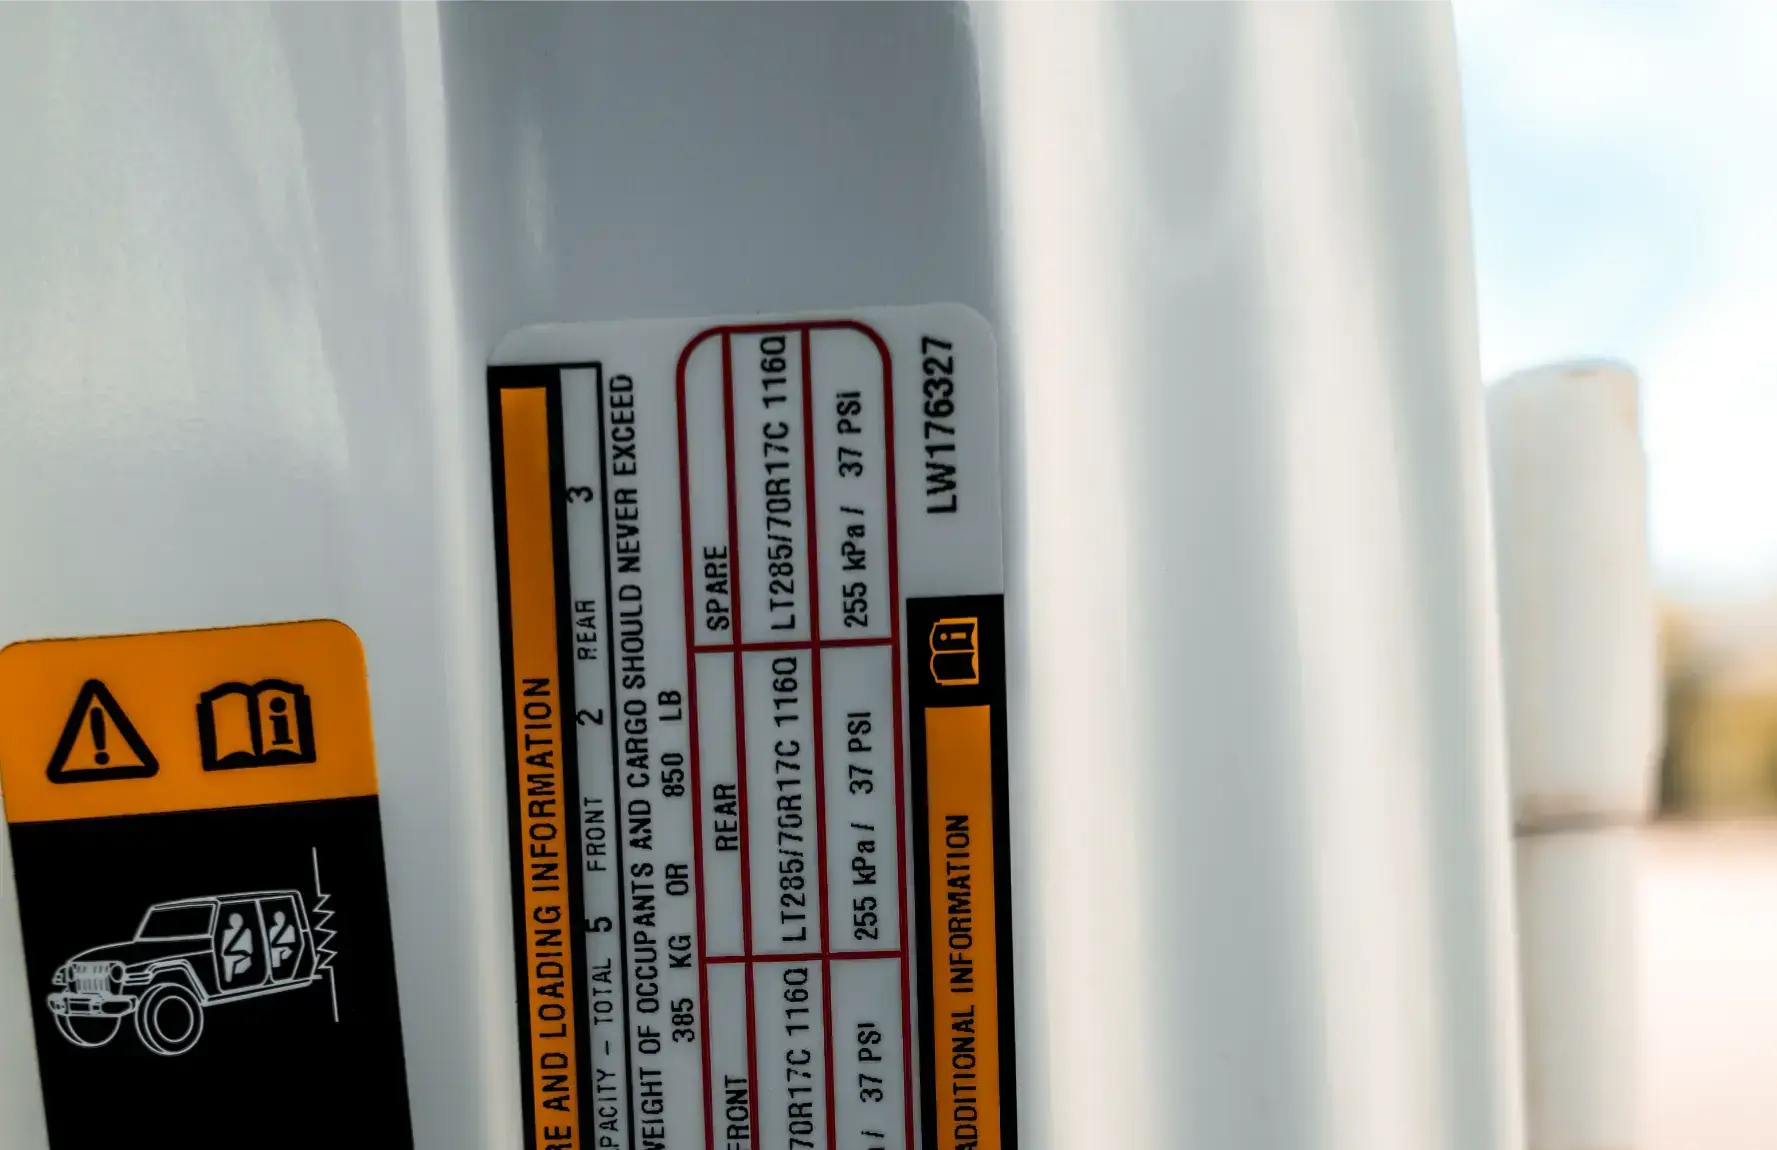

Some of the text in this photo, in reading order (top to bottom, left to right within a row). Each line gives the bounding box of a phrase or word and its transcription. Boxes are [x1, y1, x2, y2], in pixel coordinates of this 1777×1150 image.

[609, 374, 637, 477] EXCEED
[921, 335, 958, 514] LW176327
[565, 486, 594, 506] 3
[759, 335, 796, 630] LT285/70R17C 116Q
[836, 391, 868, 628] 255 kPa / 37 PSI
[614, 488, 641, 573] NEVER
[574, 600, 598, 661] REAR
[703, 545, 730, 631] SPARE
[618, 584, 646, 690] SHOULD
[574, 706, 604, 728] 2
[623, 699, 650, 788] CARGO
[522, 677, 560, 893] INFORMATION
[627, 799, 653, 851] AND
[712, 783, 739, 852] REAR
[771, 656, 807, 942] LT285/70R17C 116Q
[846, 711, 879, 941] 255 kPa / 37 PSI
[583, 796, 607, 872] FRONT
[658, 690, 696, 1043] 385 KG OR 850 LB
[583, 914, 613, 935] 5
[630, 862, 660, 1014] OCCUPANTS
[945, 815, 974, 993] INFORMATION
[532, 904, 568, 1040] LOADING
[591, 957, 614, 1026] TOTAL
[783, 967, 810, 1037] 116Q
[540, 1052, 571, 1112] AND
[637, 1025, 661, 1055] OF
[857, 1022, 882, 1062] PSI
[858, 1073, 884, 1103] 37
[860, 1130, 885, 1139] /
